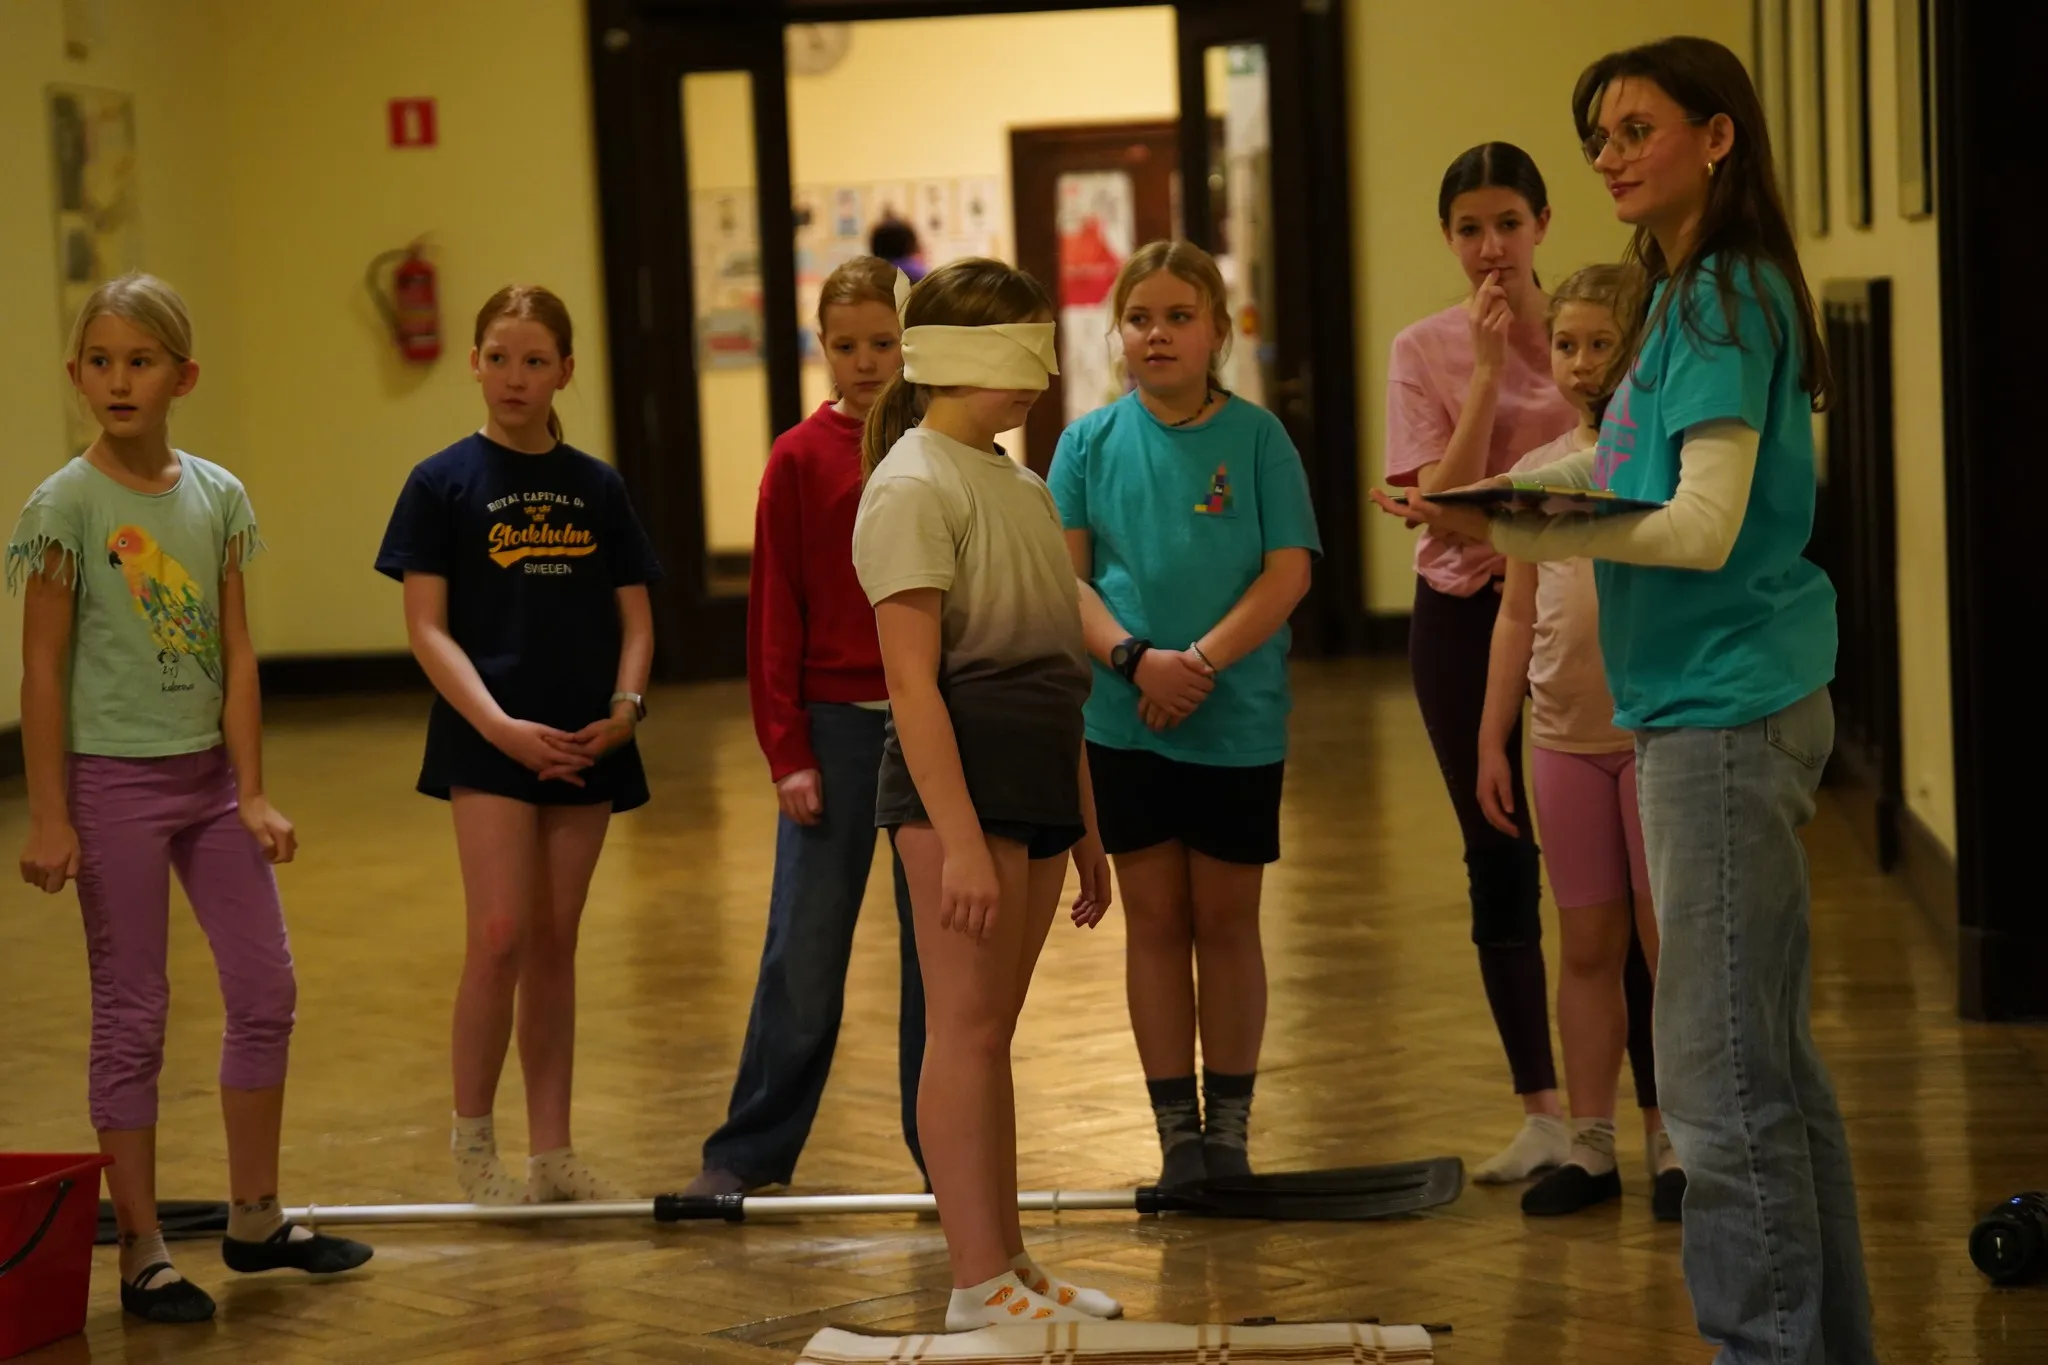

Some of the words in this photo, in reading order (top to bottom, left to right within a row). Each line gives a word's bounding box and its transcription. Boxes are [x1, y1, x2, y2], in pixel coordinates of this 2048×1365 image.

[487, 493, 520, 512] ROYAL
[523, 491, 570, 505] CAPITAL
[488, 522, 593, 553] Stockholm
[523, 563, 572, 575] SWEDEN
